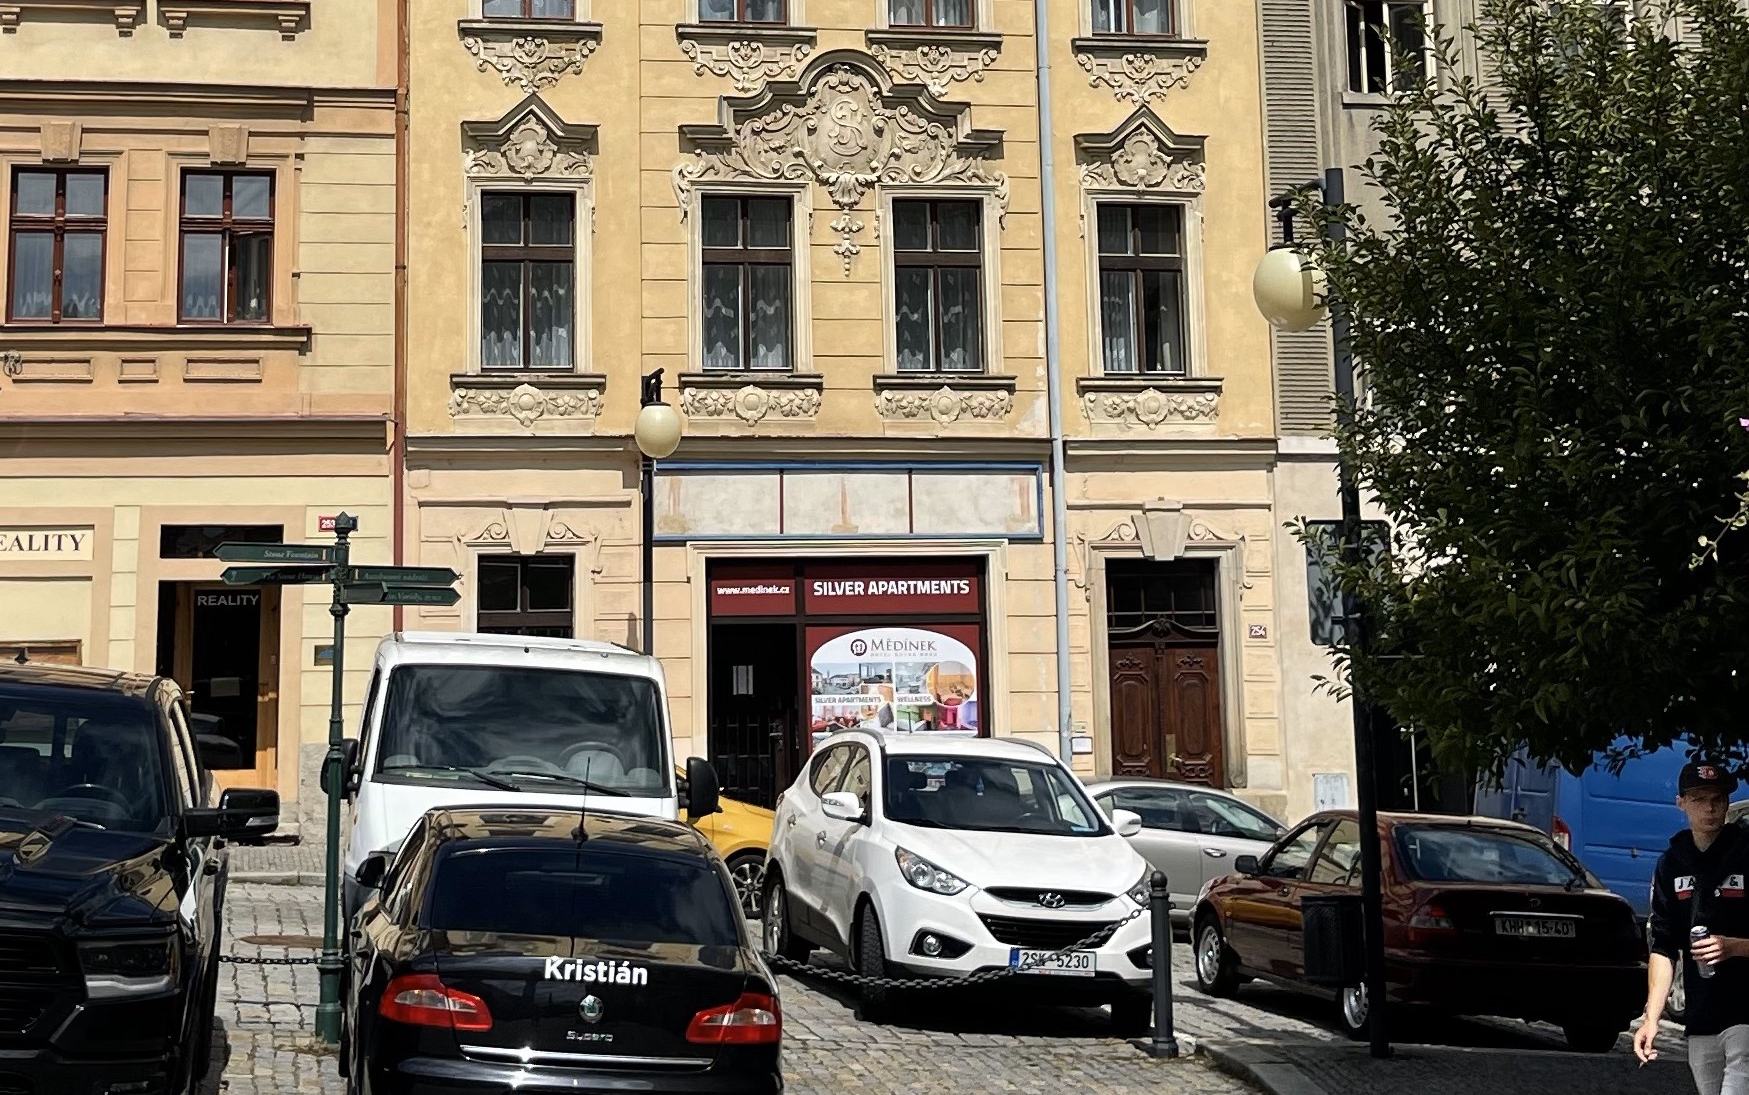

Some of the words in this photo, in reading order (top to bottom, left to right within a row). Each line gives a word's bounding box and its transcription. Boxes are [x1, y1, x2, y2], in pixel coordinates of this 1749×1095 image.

[813, 581, 865, 596] SILVER
[867, 579, 970, 595] APARTMENTS
[197, 594, 259, 606] REALITY
[544, 955, 648, 985] Kristián
